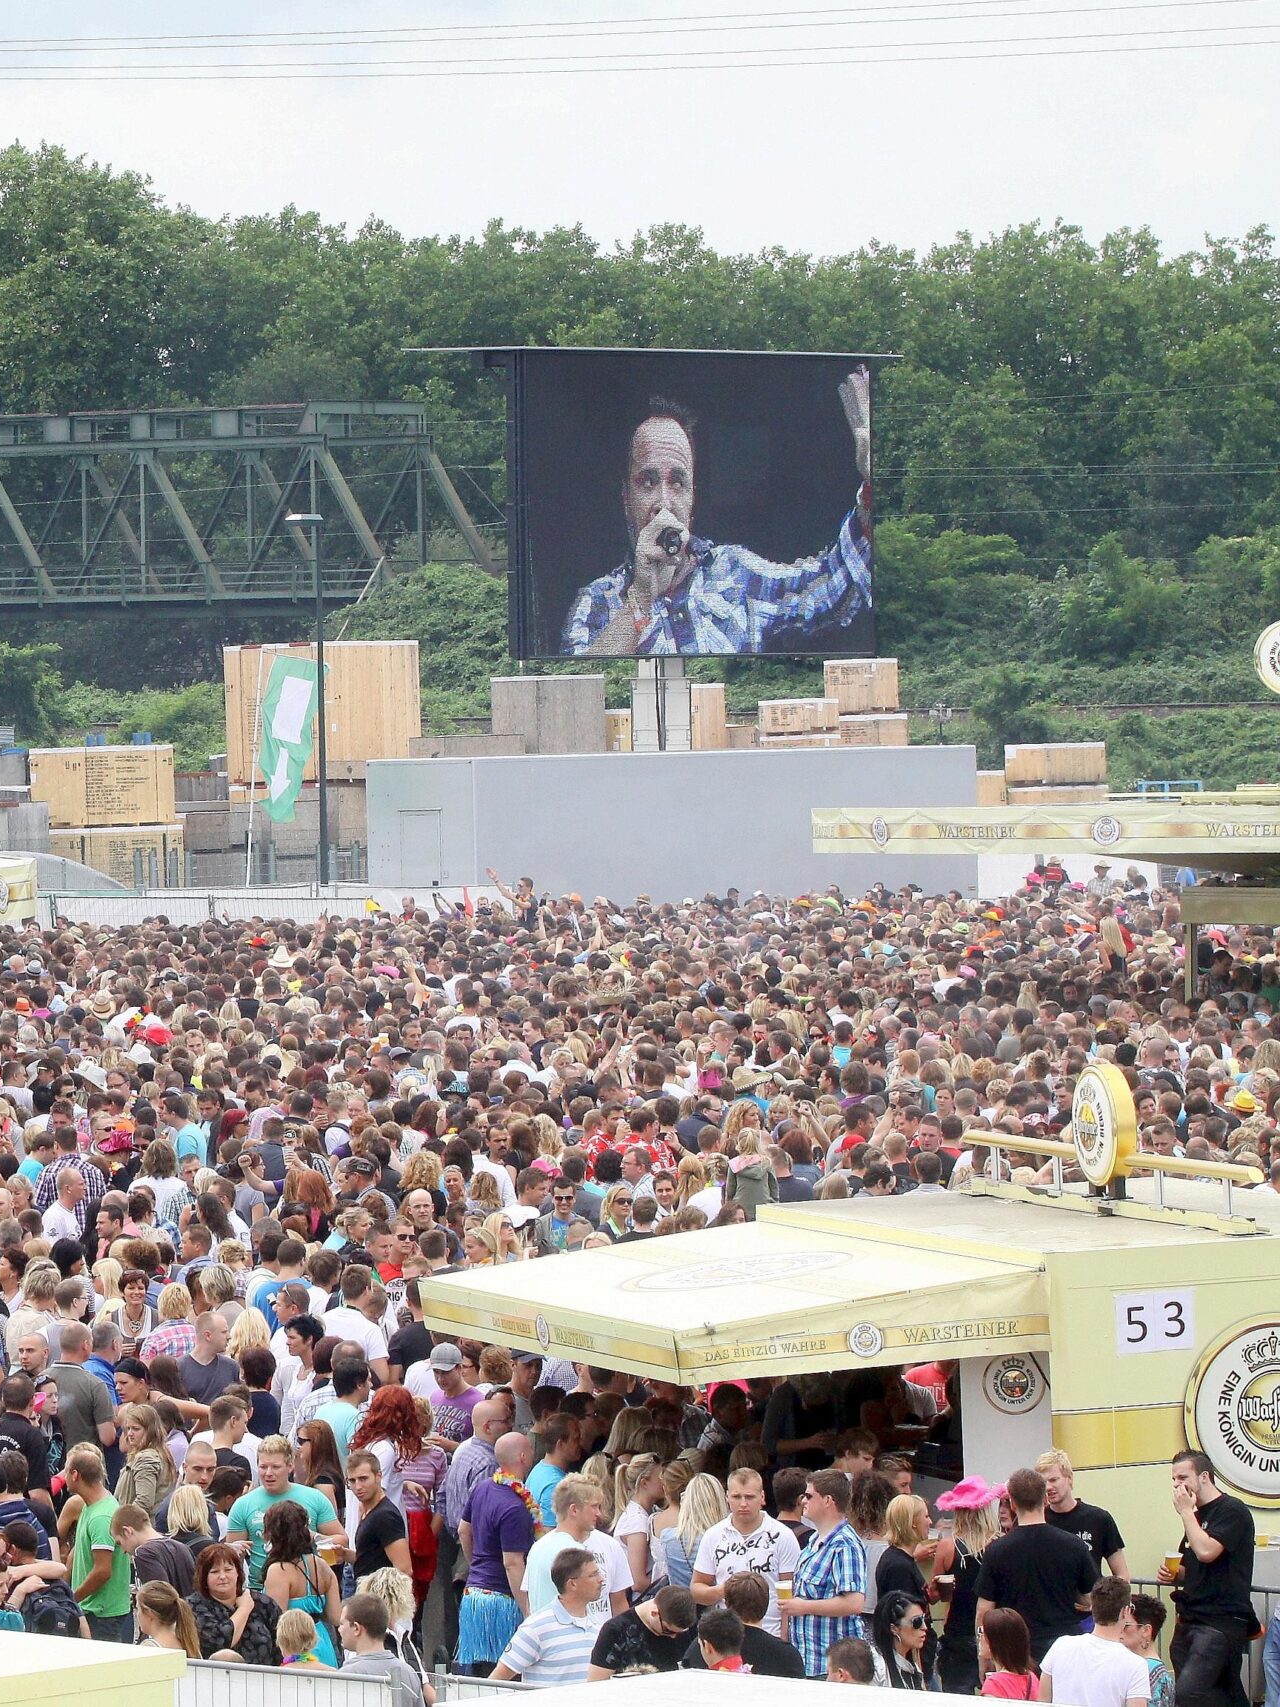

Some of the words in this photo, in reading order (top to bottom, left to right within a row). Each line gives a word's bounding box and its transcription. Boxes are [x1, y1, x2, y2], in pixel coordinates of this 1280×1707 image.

[903, 1319, 1019, 1343] WARSTEINER
[704, 1349, 730, 1363] DAS
[1218, 1370, 1242, 1406] EINE
[1218, 1411, 1257, 1467] KÖNIGIN
